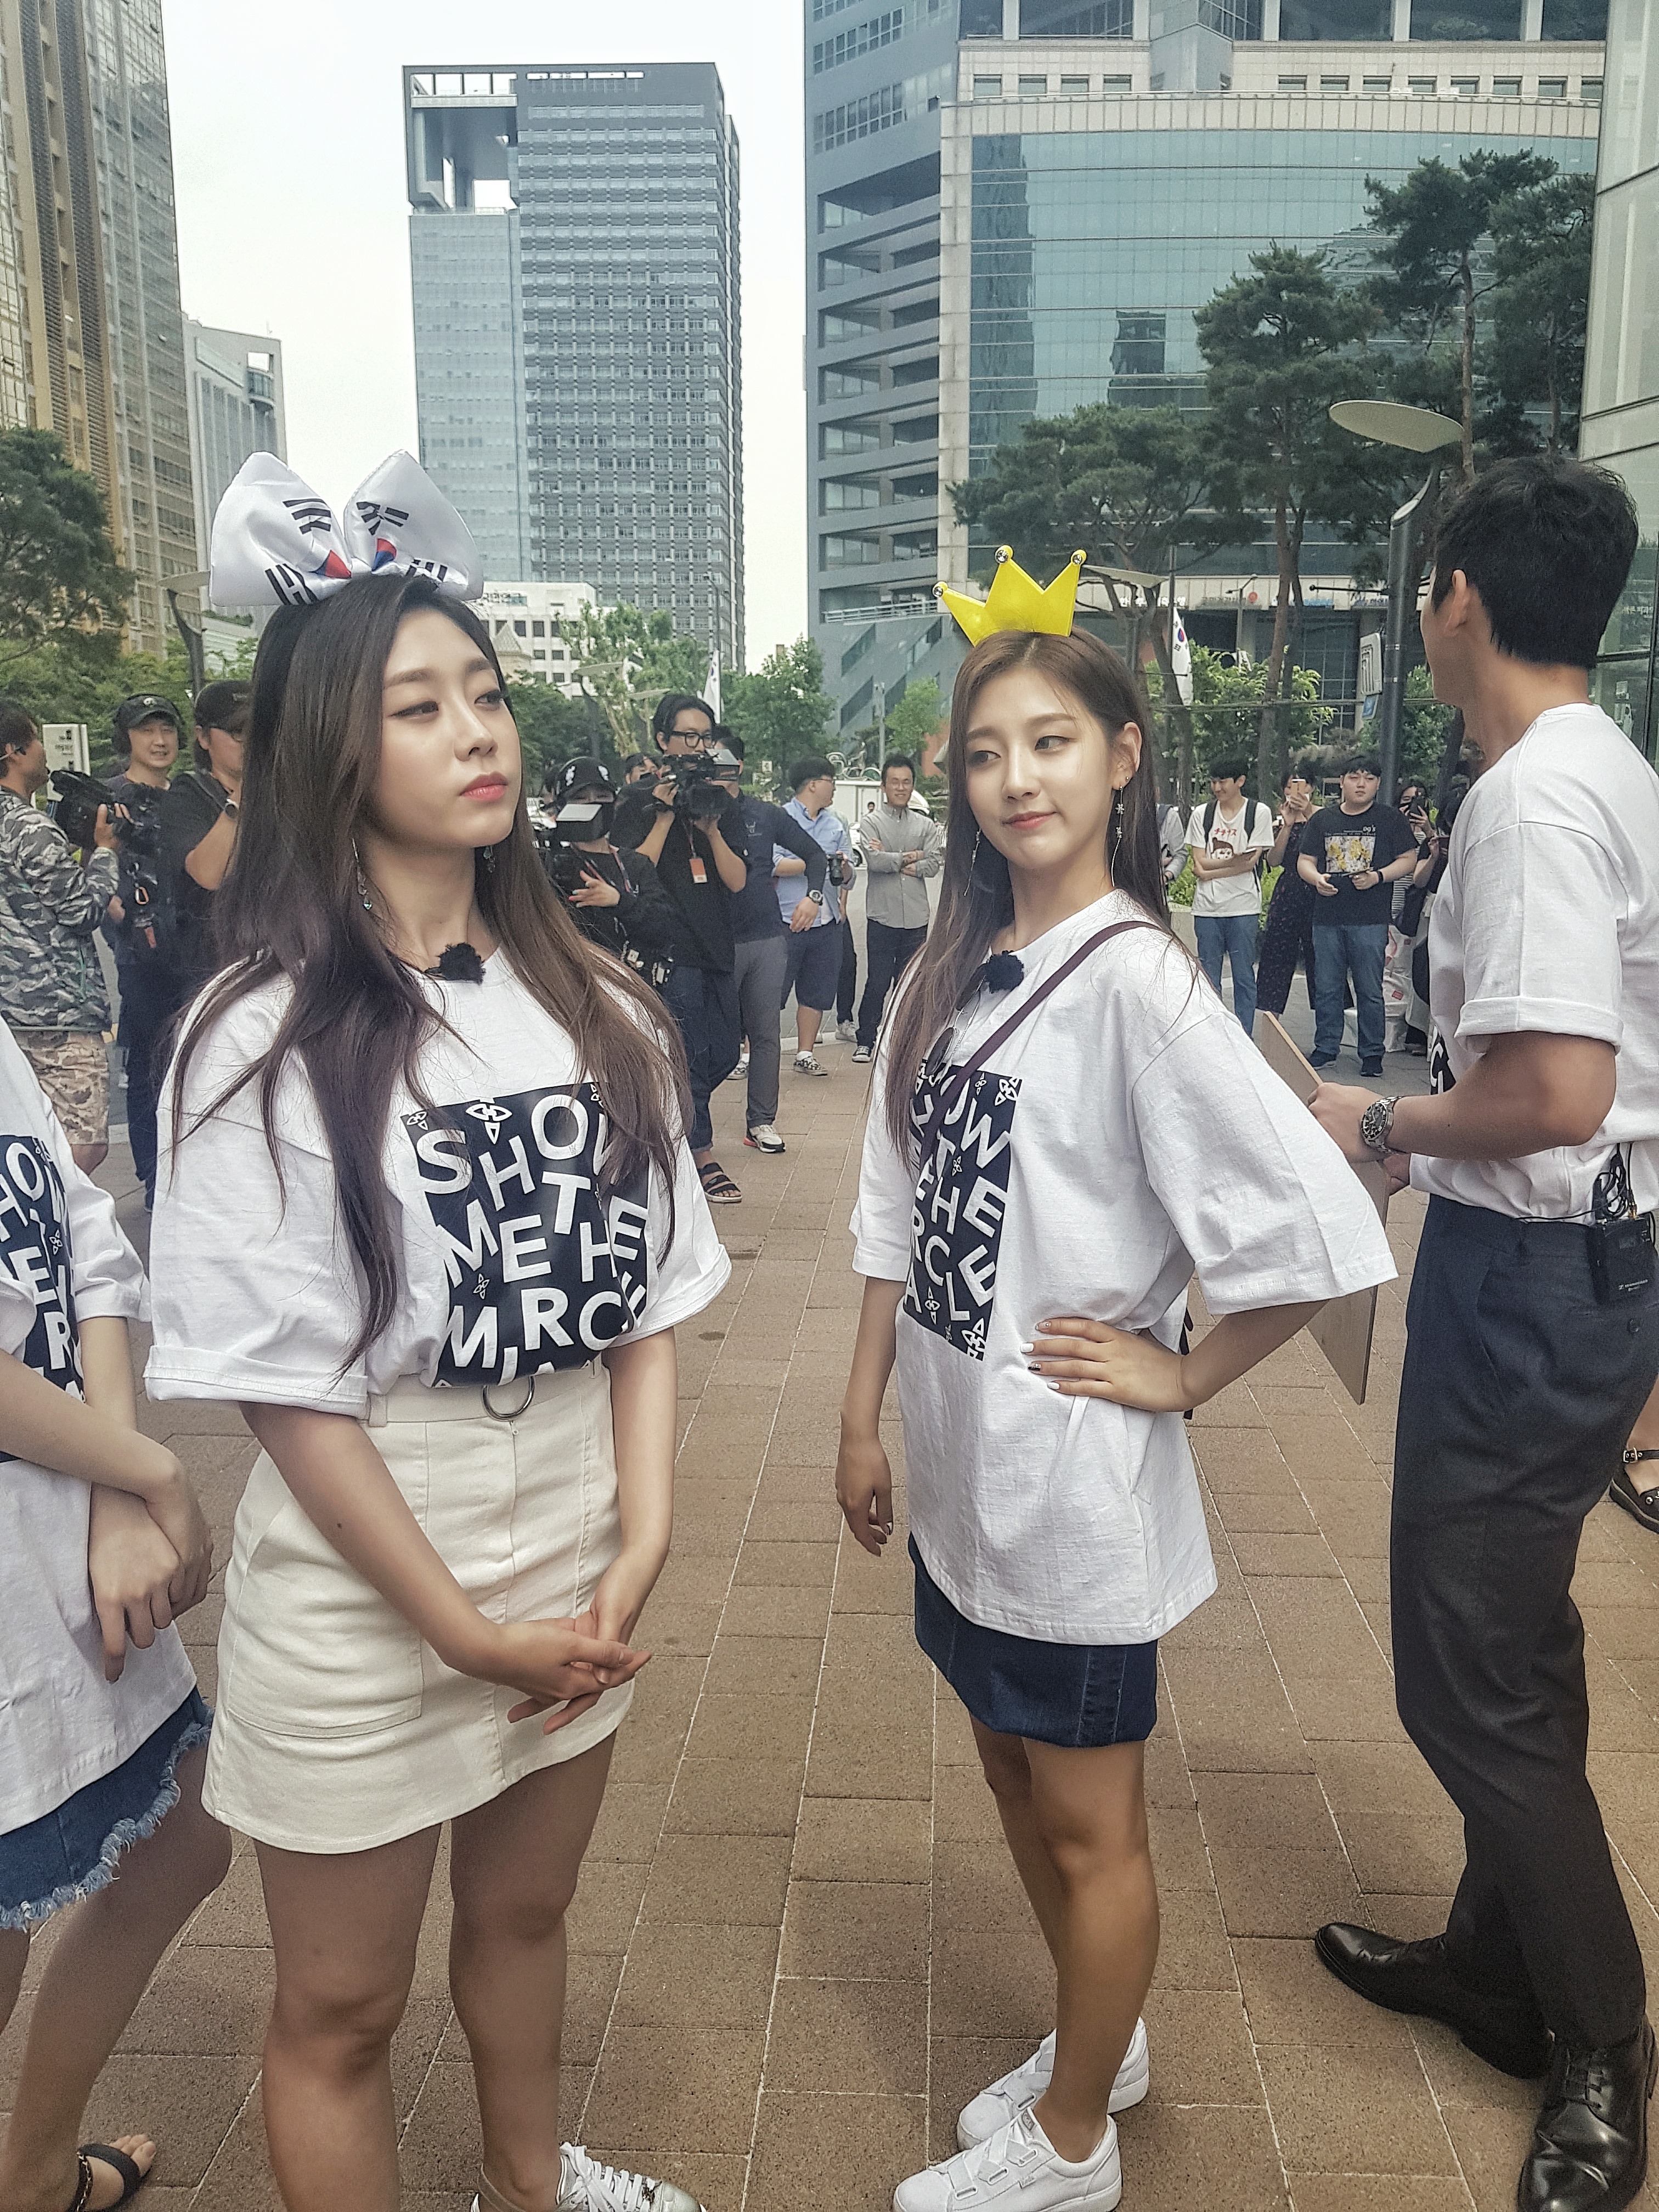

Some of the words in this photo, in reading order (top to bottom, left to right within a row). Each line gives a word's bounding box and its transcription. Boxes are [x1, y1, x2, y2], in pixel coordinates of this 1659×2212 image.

[0, 1142, 66, 1242] HOW
[416, 1094, 610, 1211] SHO
[436, 1199, 552, 1287] ME
[541, 1171, 648, 1283] THE
